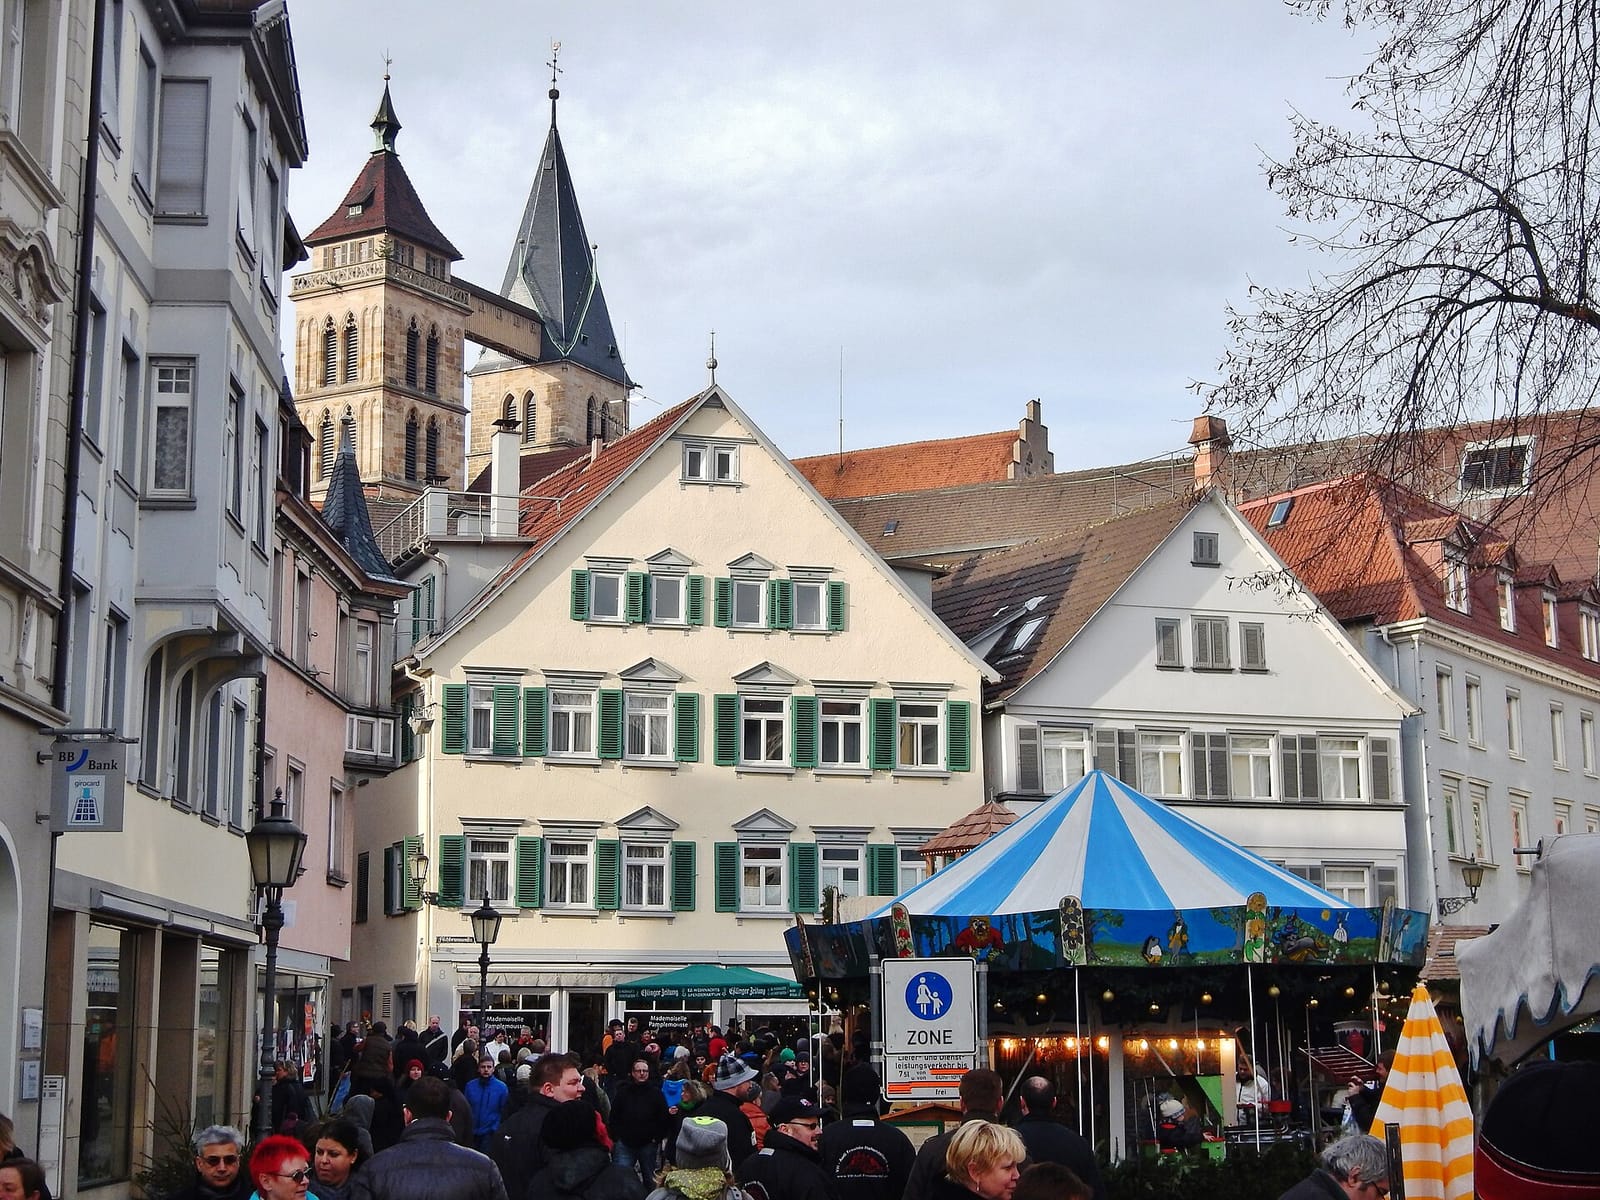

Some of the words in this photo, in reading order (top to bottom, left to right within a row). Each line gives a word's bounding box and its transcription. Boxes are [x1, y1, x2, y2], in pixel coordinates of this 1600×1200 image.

[58, 751, 75, 762] BB
[88, 759, 118, 770] Bank
[74, 780, 100, 788] girocard
[907, 1029, 953, 1045] ZONE
[895, 1062, 955, 1070] leistungsverkehr
[935, 1088, 947, 1096] frei
